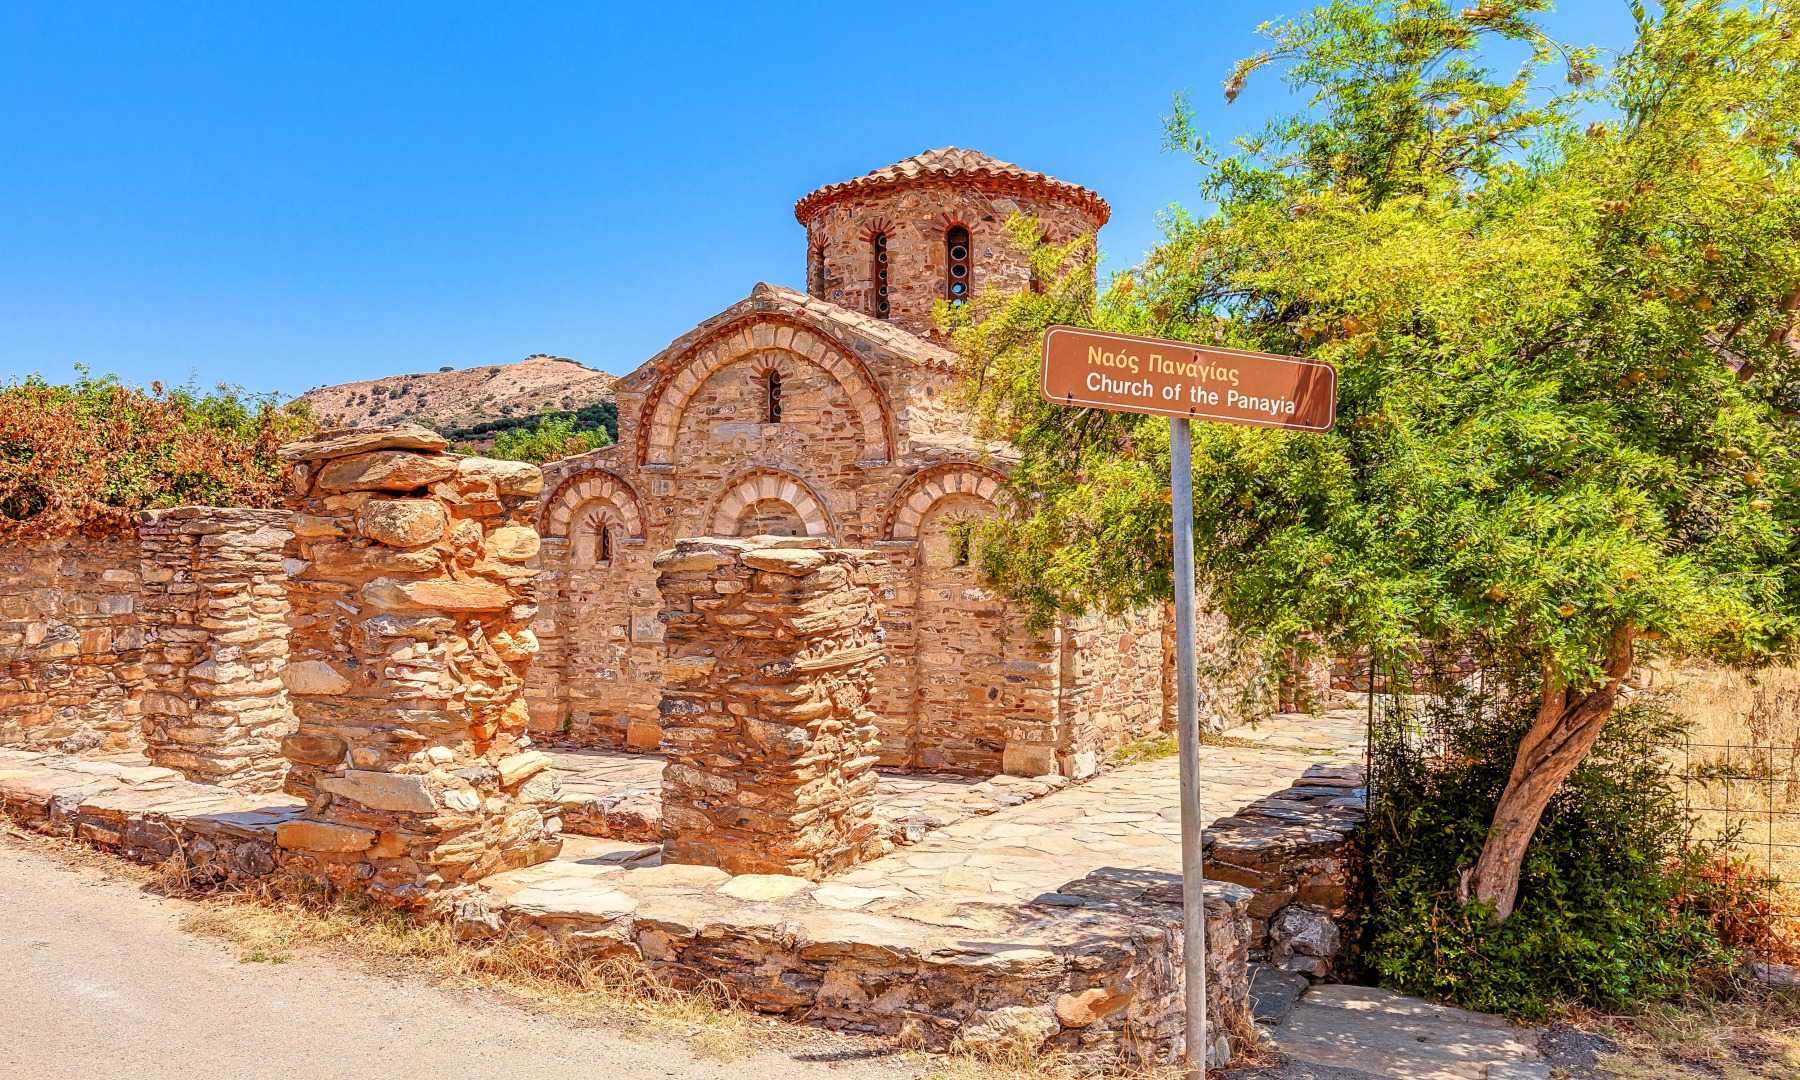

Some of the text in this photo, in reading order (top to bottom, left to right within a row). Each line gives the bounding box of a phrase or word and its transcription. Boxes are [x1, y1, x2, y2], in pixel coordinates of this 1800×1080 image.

[1088, 346, 1239, 387] Ναός Παναγίας
[1086, 372, 1295, 416] Church of the Panayia
